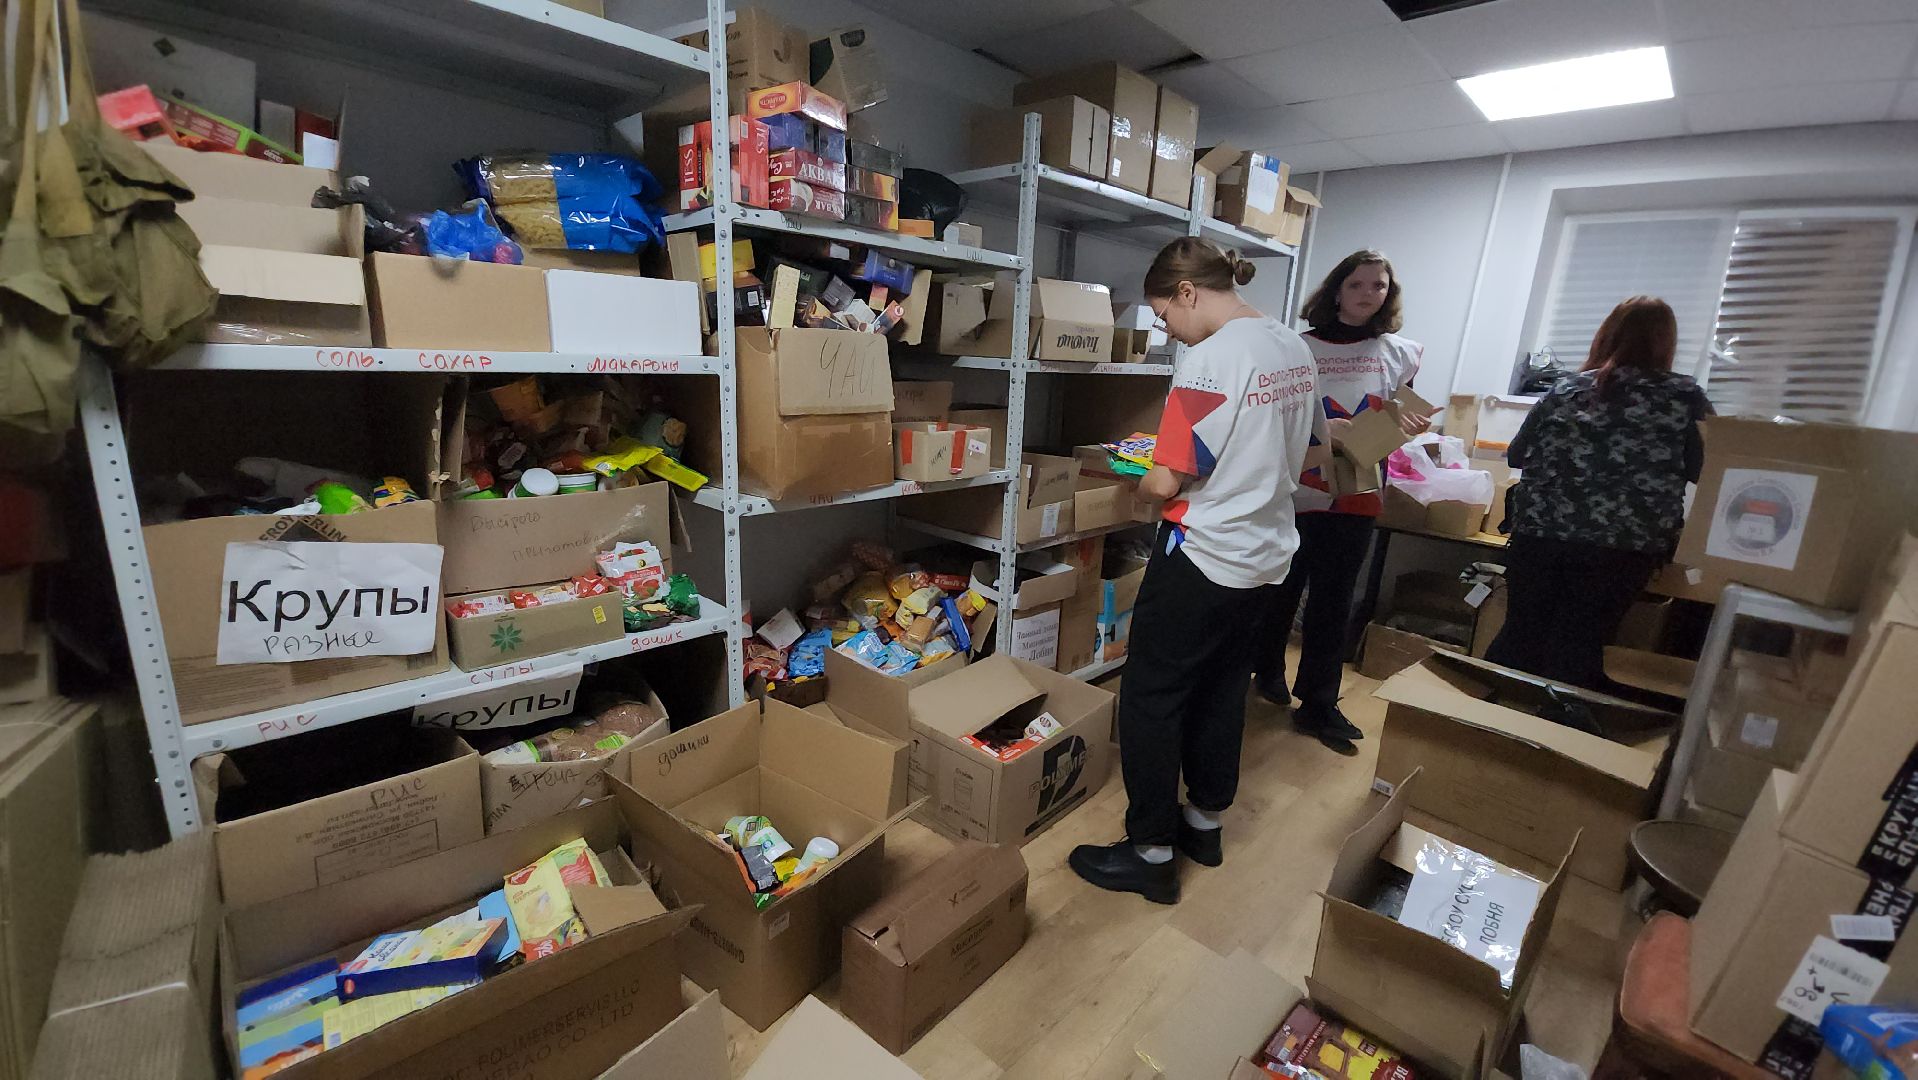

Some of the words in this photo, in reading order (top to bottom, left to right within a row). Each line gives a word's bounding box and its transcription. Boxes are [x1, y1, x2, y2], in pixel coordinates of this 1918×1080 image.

[755, 127, 765, 154] TESS
[683, 148, 694, 183] TESS
[316, 349, 374, 368] СОЛЬ
[418, 352, 493, 370] САХАР
[227, 579, 430, 633] Крупы
[470, 662, 534, 685] СУПЫ
[417, 689, 571, 728] Крупы
[257, 713, 318, 741] РИС
[1479, 901, 1505, 946] ЛОБНЯ
